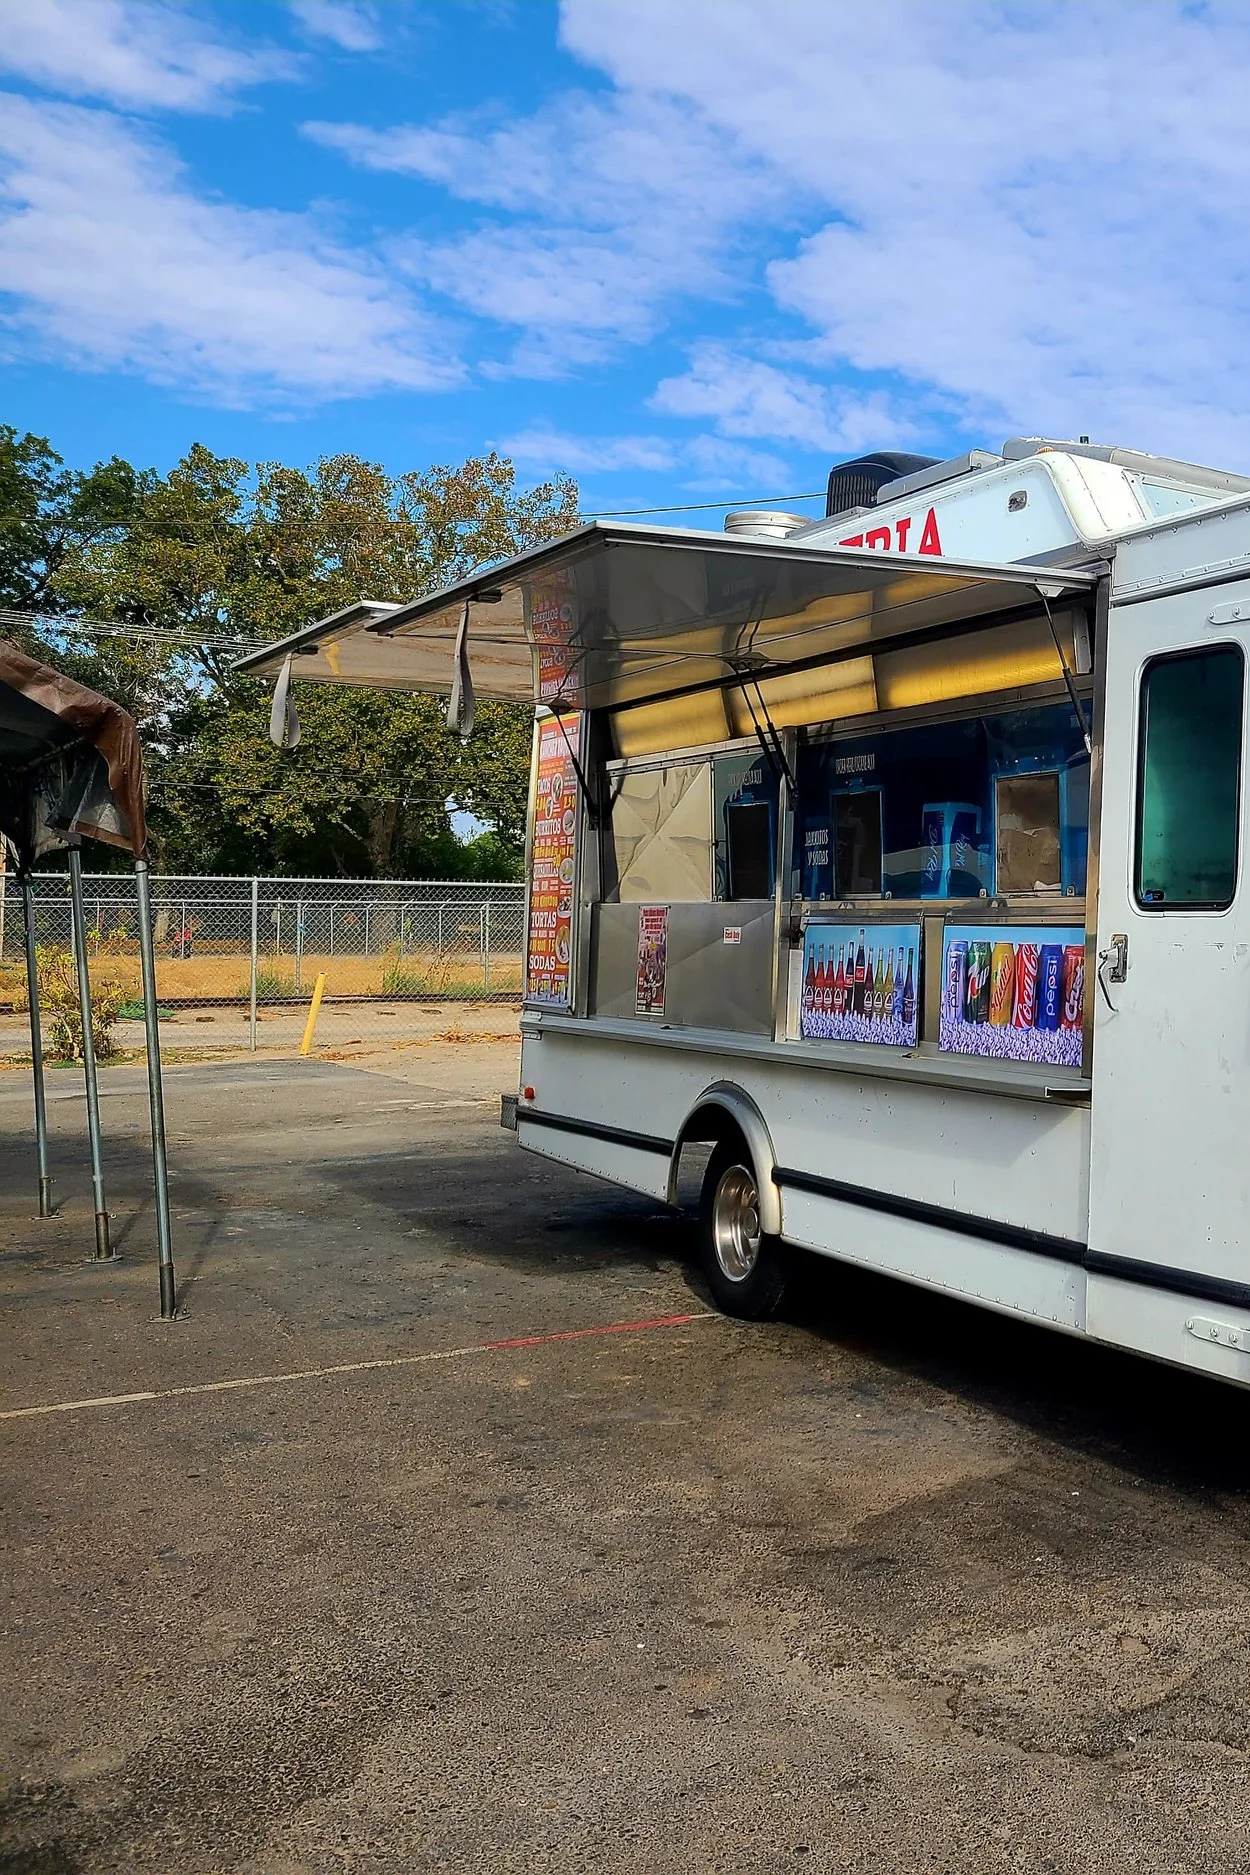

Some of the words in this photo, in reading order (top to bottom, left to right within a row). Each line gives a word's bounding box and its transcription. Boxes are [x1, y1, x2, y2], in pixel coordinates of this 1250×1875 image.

[531, 911, 557, 928] TORTAS
[529, 954, 556, 970] SODAS
[1046, 959, 1058, 1016] pepsi
